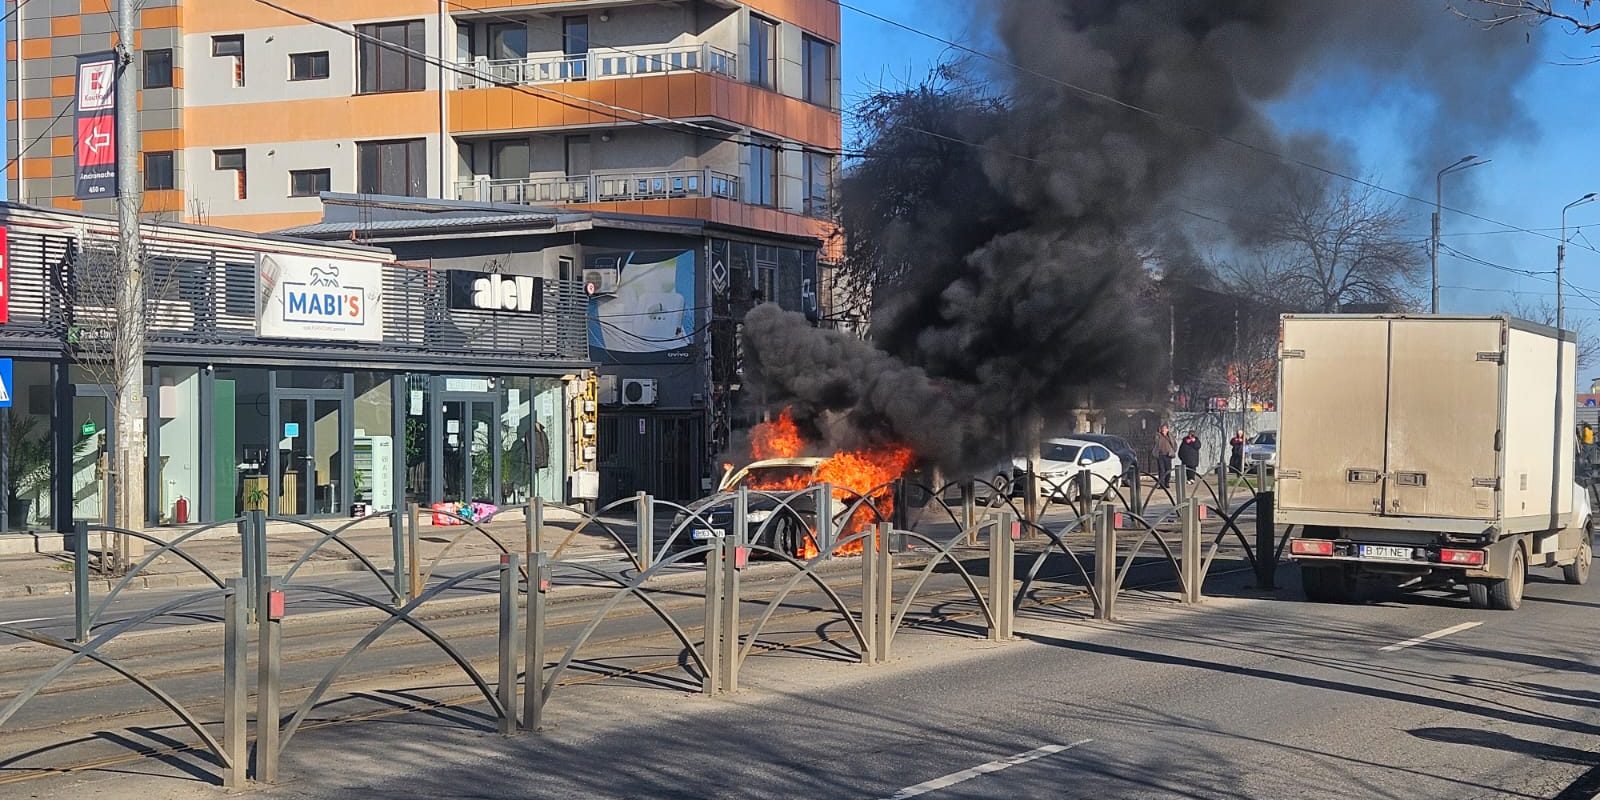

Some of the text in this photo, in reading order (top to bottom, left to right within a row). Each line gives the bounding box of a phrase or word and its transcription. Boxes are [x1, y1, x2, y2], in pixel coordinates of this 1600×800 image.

[289, 291, 359, 317] MABI'S
[471, 273, 534, 312] alev
[1366, 546, 1409, 557] B 171 NET
